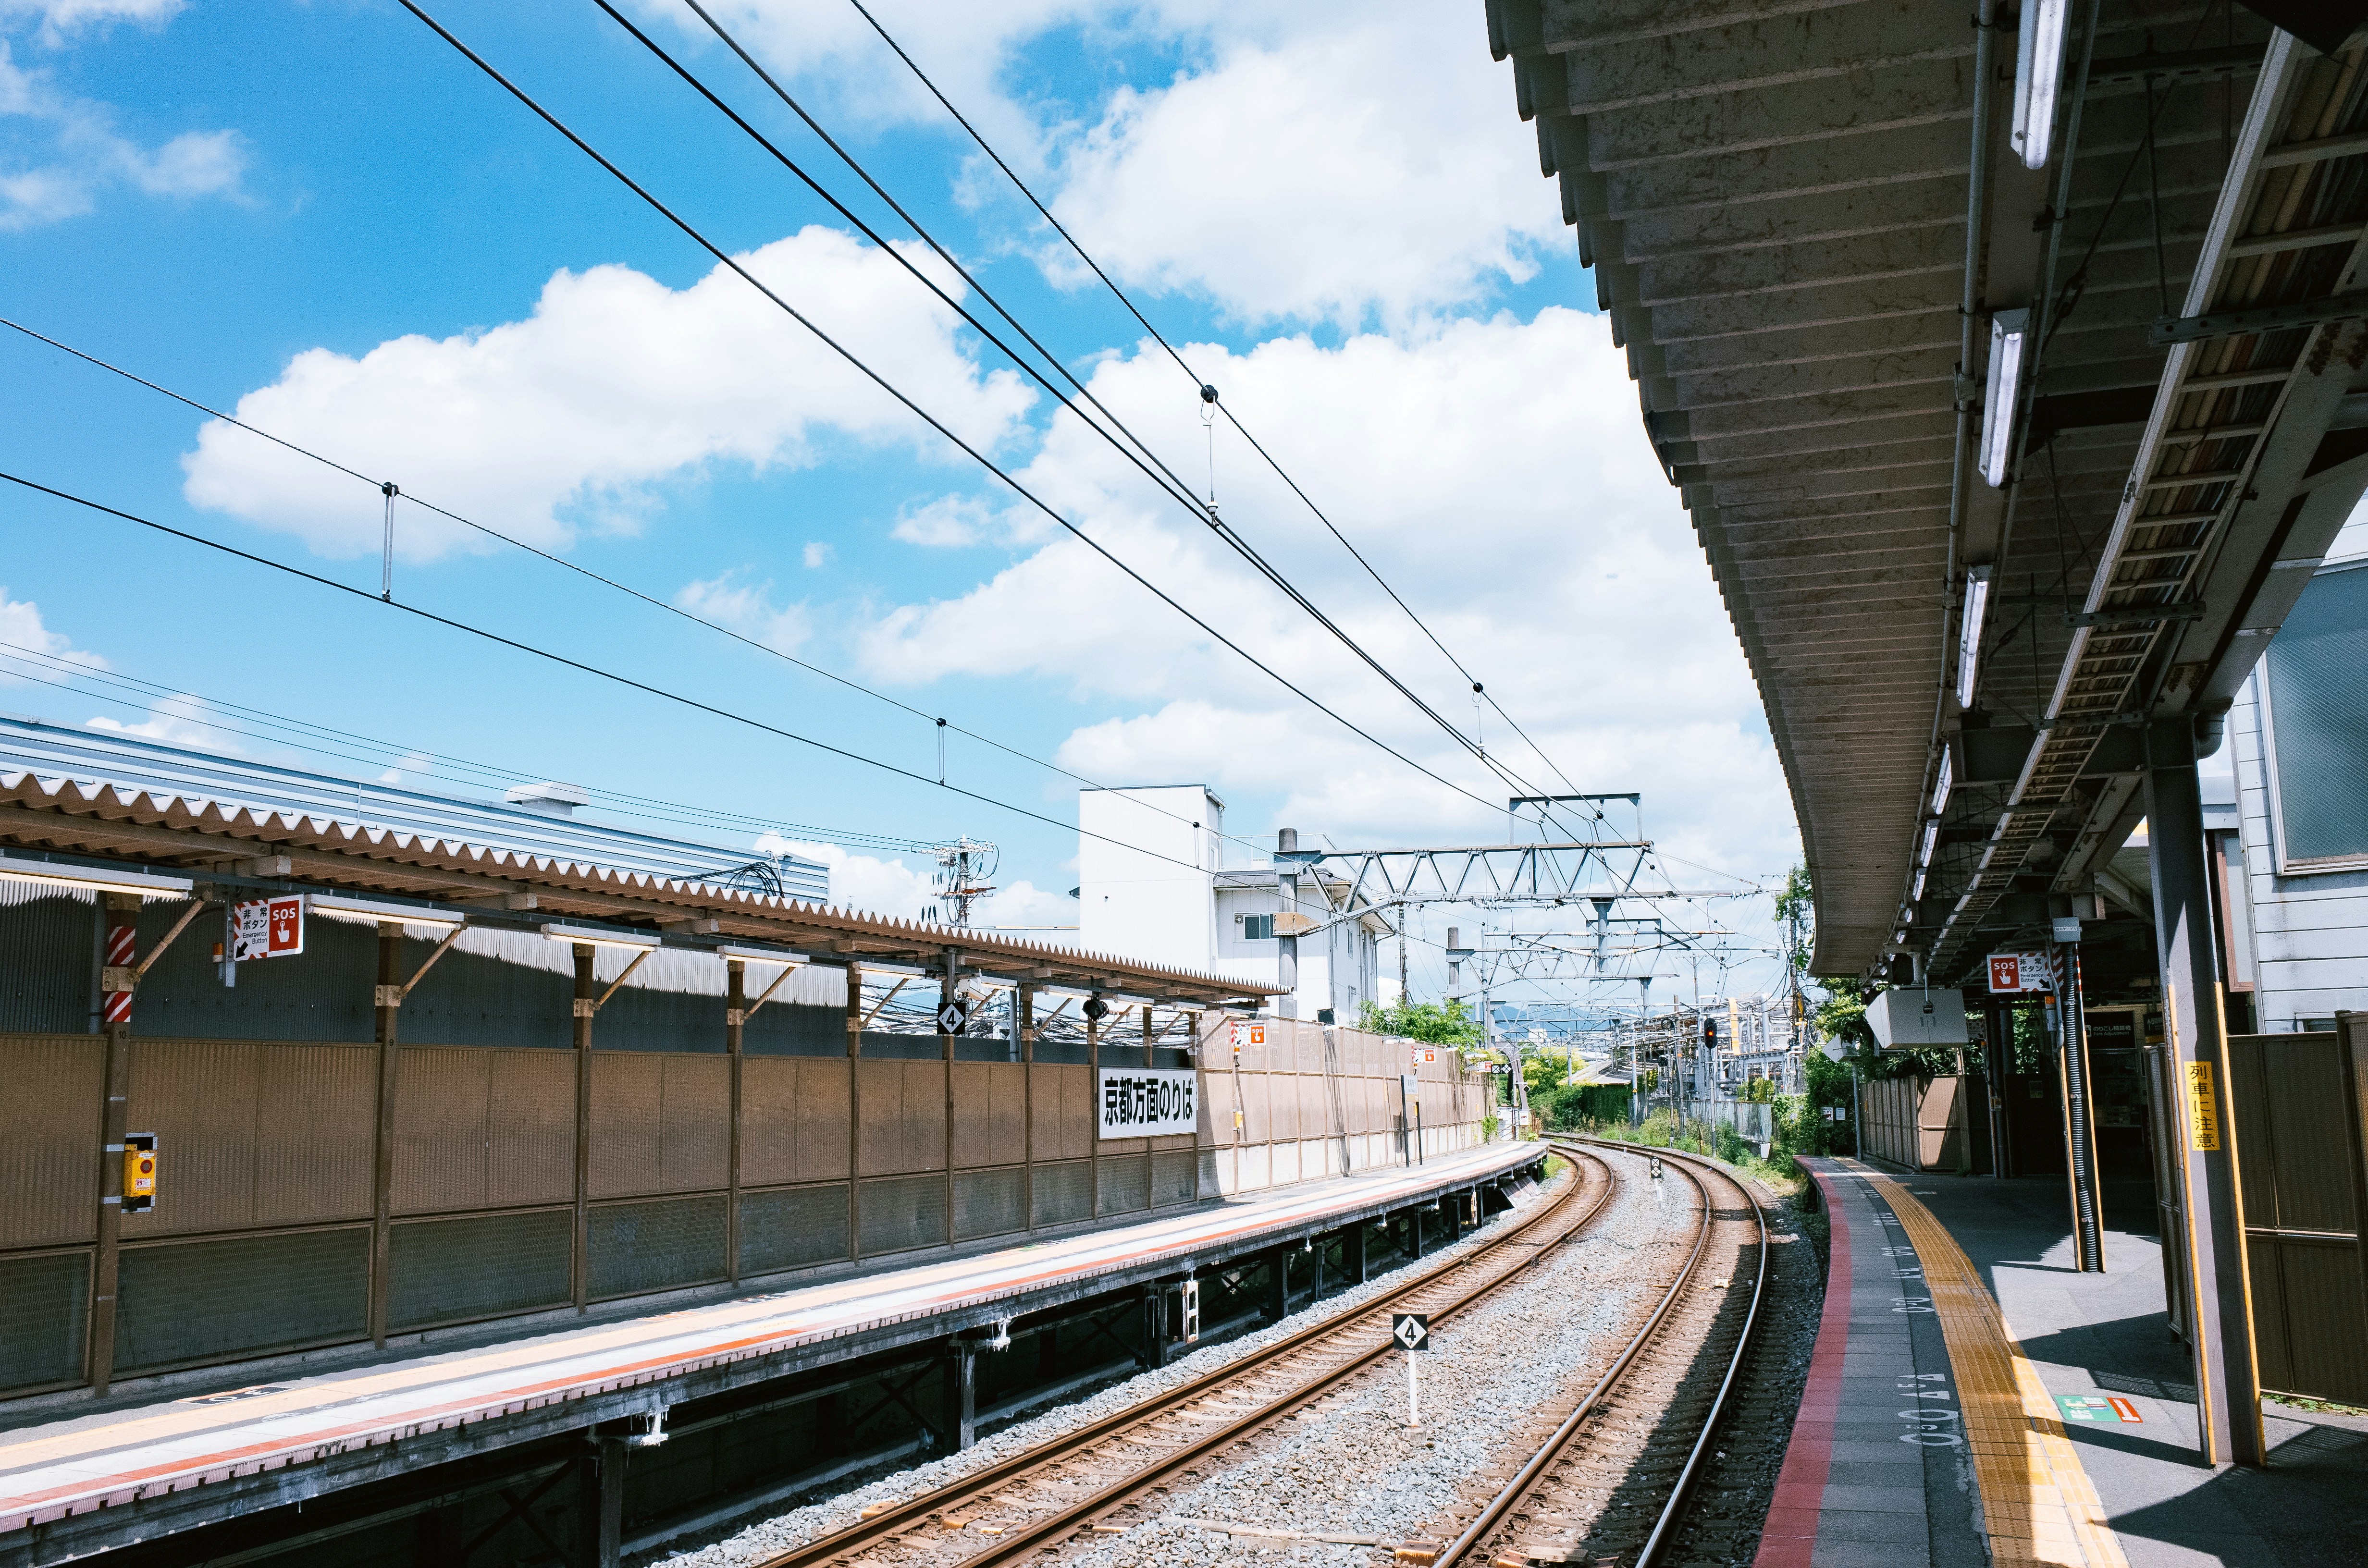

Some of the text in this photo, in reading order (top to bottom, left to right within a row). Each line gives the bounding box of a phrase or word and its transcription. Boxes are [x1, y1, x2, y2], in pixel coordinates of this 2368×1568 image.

[244, 907, 267, 919] 非常
[272, 907, 296, 921] SOS
[243, 919, 267, 930] ボタン
[1994, 962, 2015, 970] SOS
[946, 1010, 956, 1027] 4
[1105, 1077, 1193, 1126] 京都方面のりば
[2190, 1066, 2215, 1147] 列車に注意
[1405, 1323, 1417, 1341] 4
